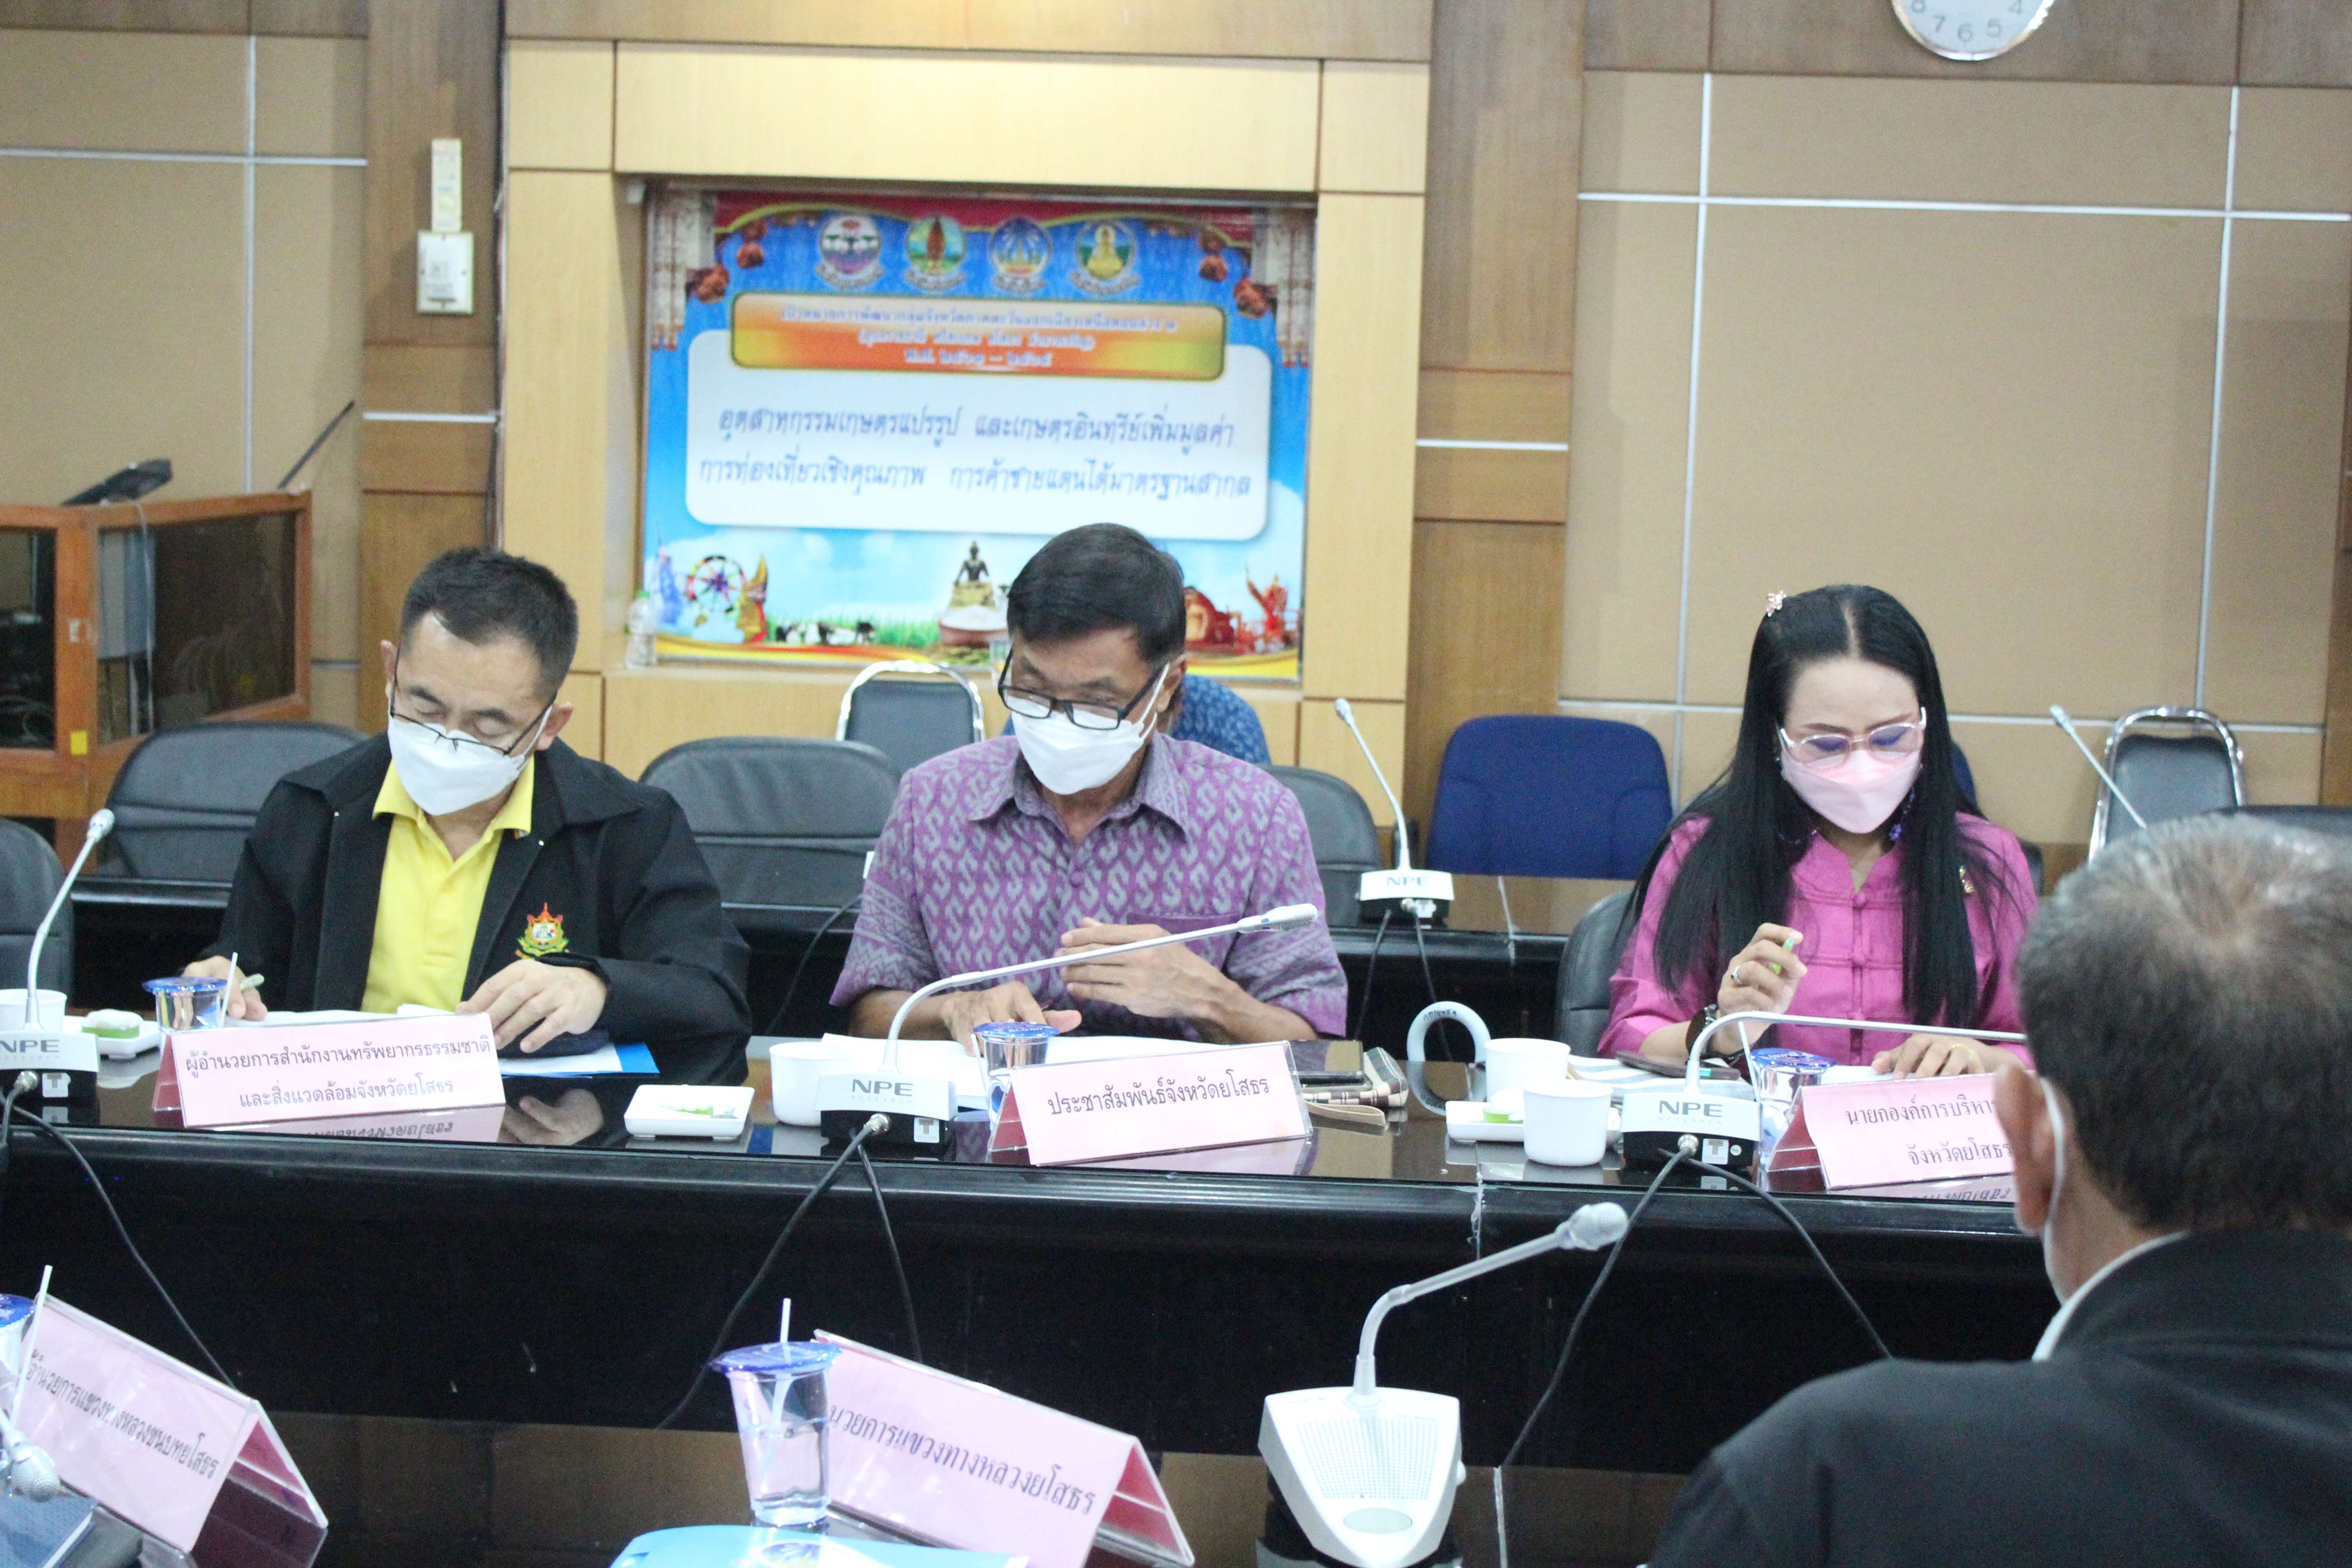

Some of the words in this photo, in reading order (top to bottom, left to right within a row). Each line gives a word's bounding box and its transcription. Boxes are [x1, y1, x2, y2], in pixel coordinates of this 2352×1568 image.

[1933, 14, 1946, 33] 7
[1957, 21, 1972, 43] 6
[1987, 18, 2002, 38] 5
[719, 404, 962, 447] อุตสาหกรรมเกษตรแปรรูป
[975, 403, 1235, 454] และเกษตรอินทรีย์เพิ่มมูลค่า
[700, 444, 926, 495] การท่องเที่ยวเชิงคุณภาพ
[950, 457, 1252, 500] การค้าชายแดนได้มาตรฐานสากล
[1387, 877, 1430, 887] NPE
[186, 1034, 490, 1078] ผู้อำนวยการสำนักงานทรัพยากรธรรมชาติ
[239, 1072, 454, 1107] และสิ่งแวดล้อมจังหวัดยโสธร
[852, 1079, 913, 1097] NPE
[1048, 1069, 1270, 1115] ประชาสัมพันธ์จังหวัดยโสธร
[851, 1095, 912, 1104] RESEARCH
[1659, 1100, 1724, 1117] NPE
[1658, 1117, 1723, 1125] RESEARCH
